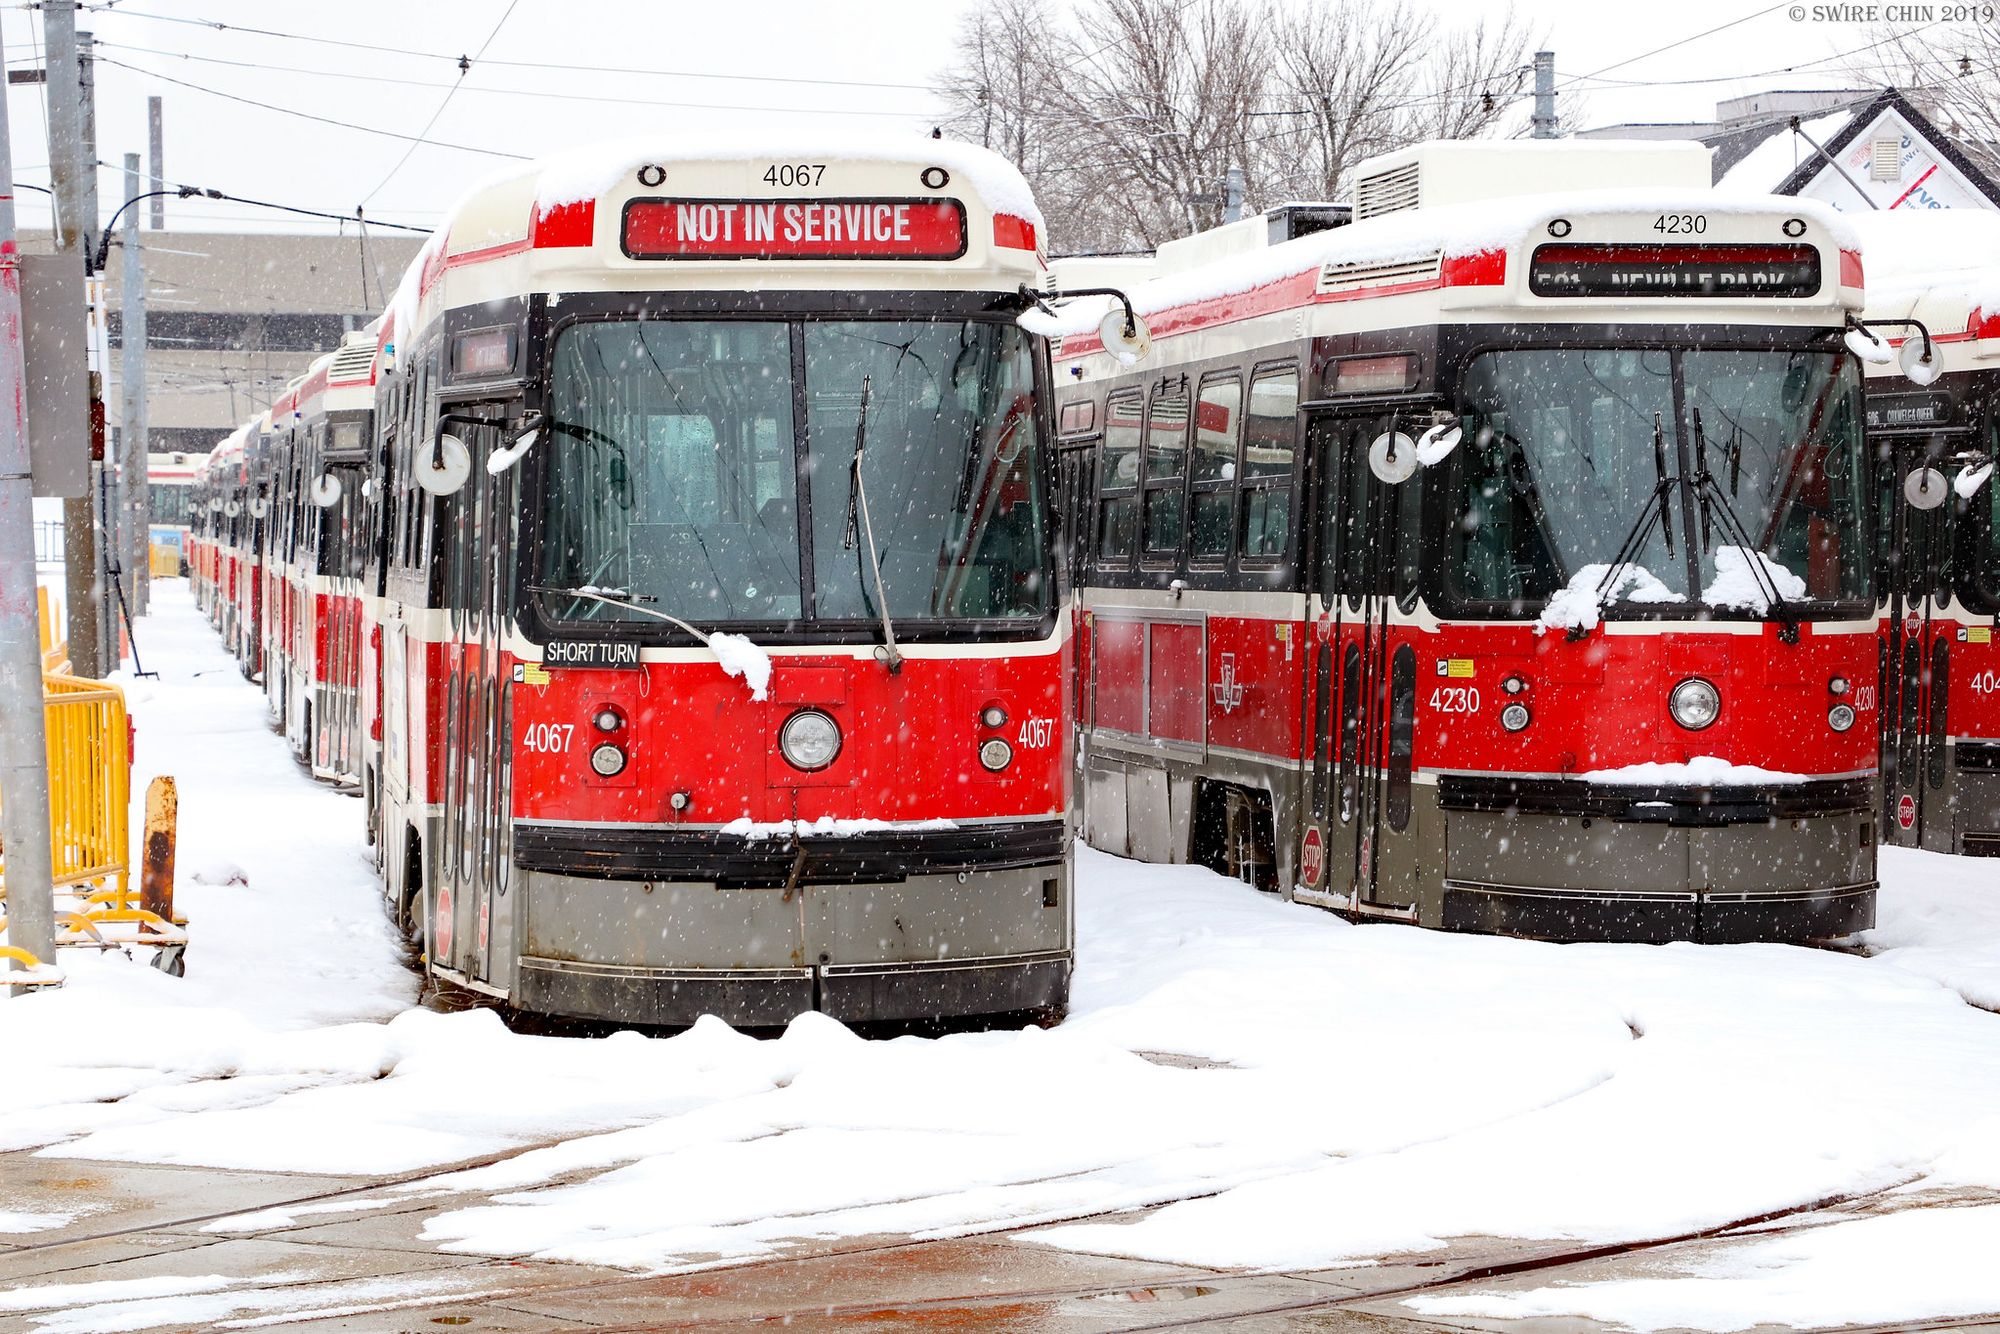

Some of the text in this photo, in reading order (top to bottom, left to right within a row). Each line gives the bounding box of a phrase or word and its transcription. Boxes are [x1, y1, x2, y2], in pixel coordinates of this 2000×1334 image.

[763, 165, 827, 187] 4067
[677, 203, 911, 242] NOT IN SERVICE
[1653, 214, 1707, 234] 4230
[1907, 619, 1921, 630] STOP
[547, 642, 638, 663] SHORT TURN
[1429, 687, 1480, 713] 4230
[1855, 685, 1875, 712] 4230
[523, 723, 575, 753] 4067
[1018, 718, 1054, 749] 4067
[1304, 844, 1321, 868] STOP
